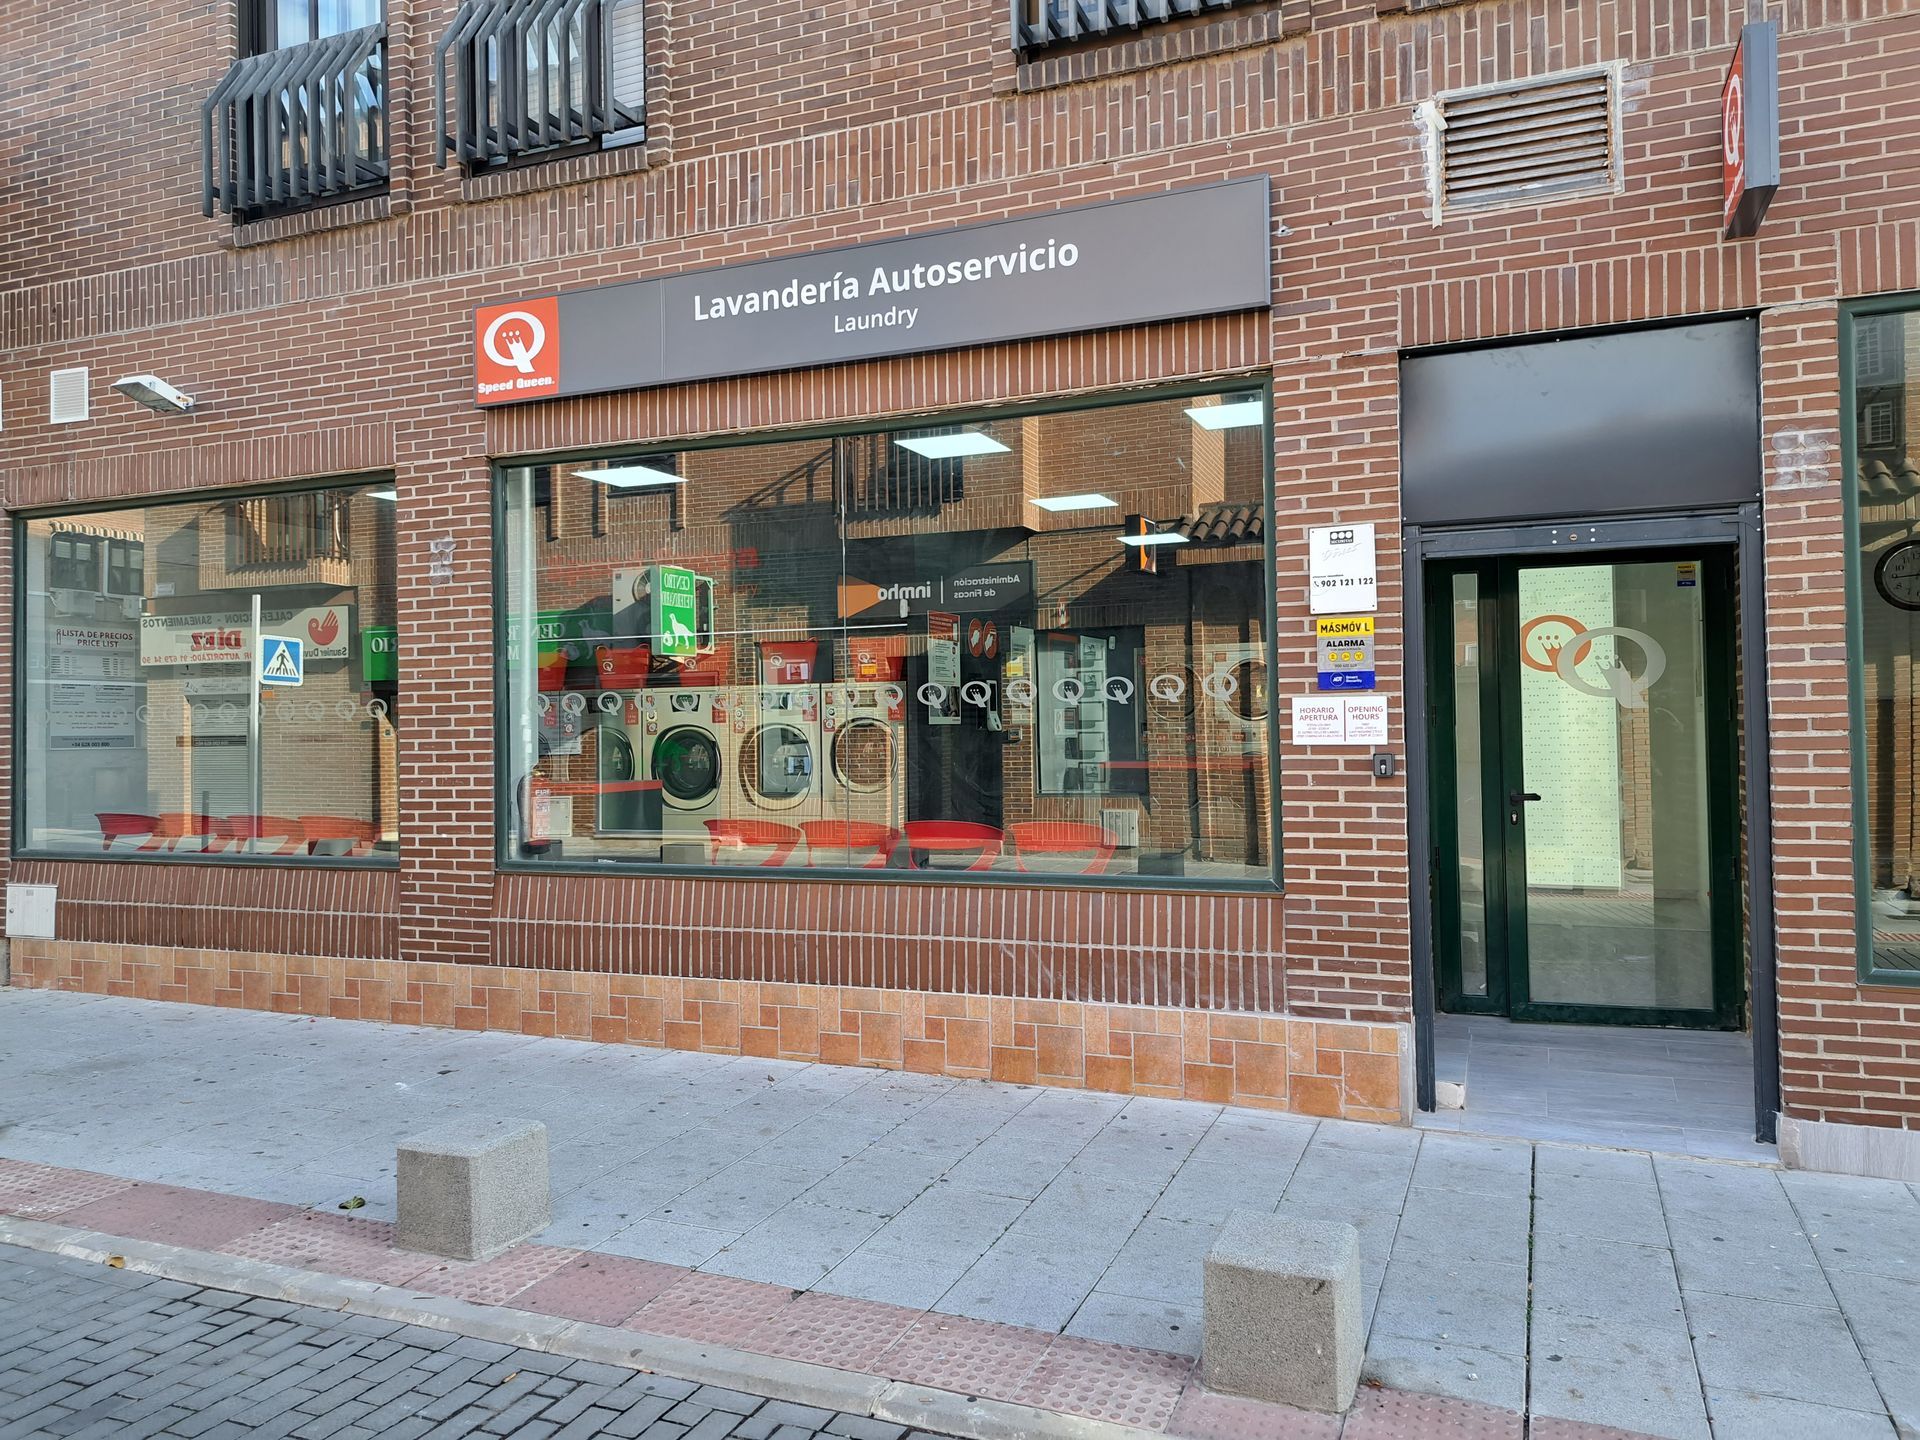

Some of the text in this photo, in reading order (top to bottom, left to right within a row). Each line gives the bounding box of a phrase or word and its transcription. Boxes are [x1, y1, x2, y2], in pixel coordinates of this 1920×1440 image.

[695, 238, 1079, 321] Lavandería Autoservicio
[834, 305, 919, 333] Laundry
[478, 379, 514, 395] Speed
[1339, 578, 1354, 586] 121
[1358, 577, 1374, 585] 122
[1320, 622, 1370, 633] MÁSMÓVL
[62, 629, 134, 641] LISTA DE PRECIOS
[77, 639, 119, 648] PRICE LIST
[1326, 639, 1366, 648] ALARMA
[1299, 706, 1335, 714] HORARIO
[1347, 705, 1384, 713] OPENING
